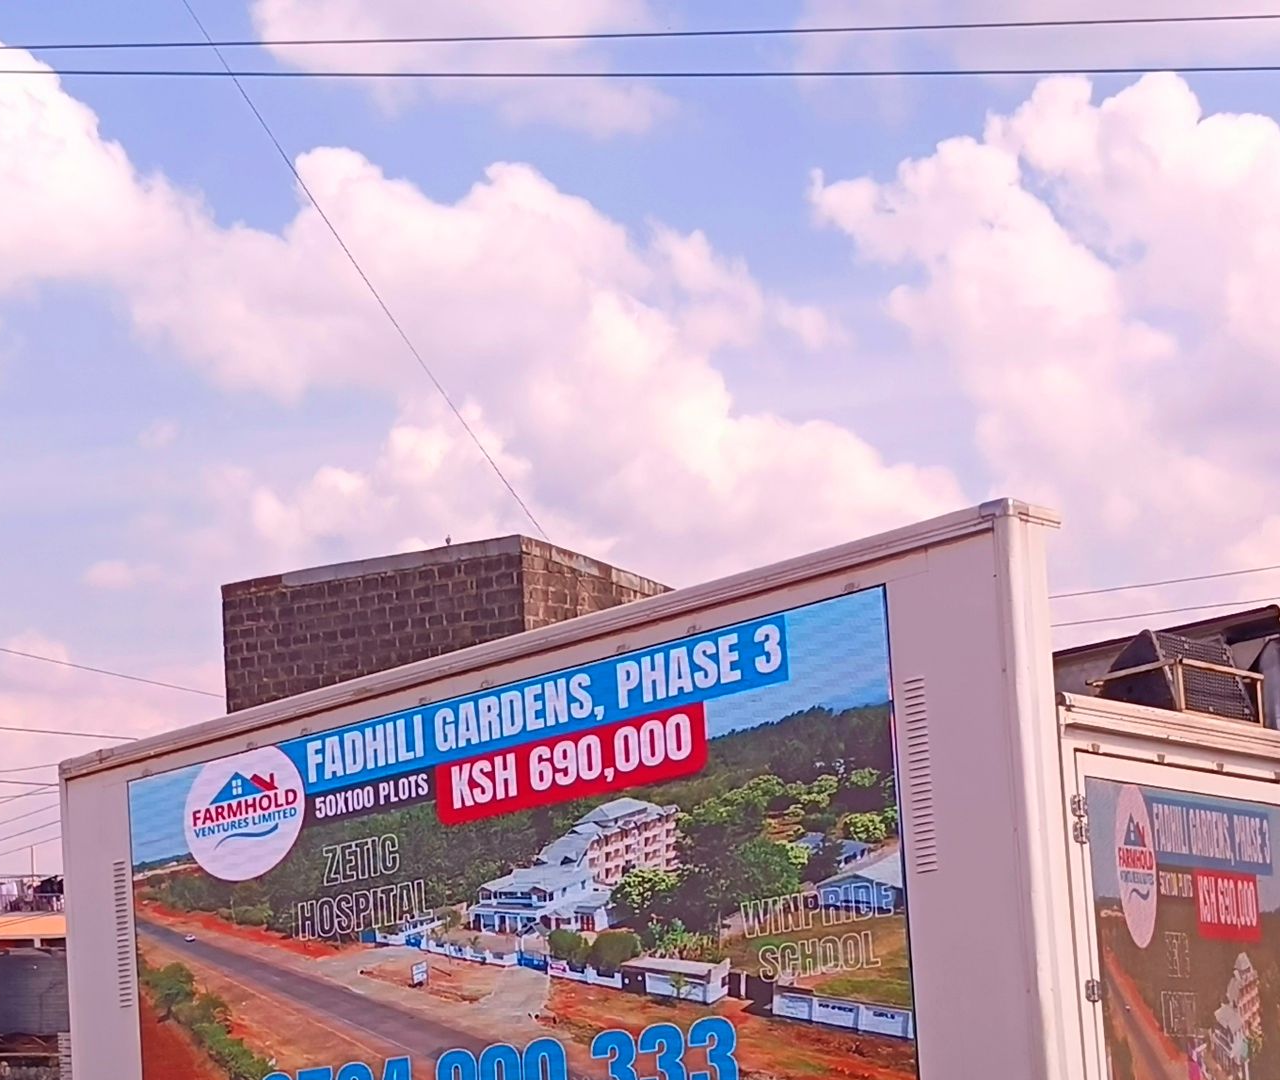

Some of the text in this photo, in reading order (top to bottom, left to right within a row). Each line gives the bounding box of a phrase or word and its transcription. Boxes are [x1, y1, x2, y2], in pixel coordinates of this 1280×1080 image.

[306, 623, 782, 784] FADHILI GARDENS, PHASE 3
[450, 714, 693, 810] KSH 690,000
[192, 788, 298, 828] FARMHOLD
[194, 806, 298, 839] VENTURES LIMITED
[314, 773, 429, 819] 50X100 PLOTS
[322, 833, 400, 887] ZETIC
[1152, 802, 1189, 853] FADHILI
[1234, 813, 1262, 865] PHASE
[1262, 818, 1271, 864] 3
[297, 879, 434, 941] HOSPITAL
[740, 879, 896, 939] WINPRIDE
[1197, 874, 1218, 924] KSH
[759, 930, 882, 983] SCHOOL
